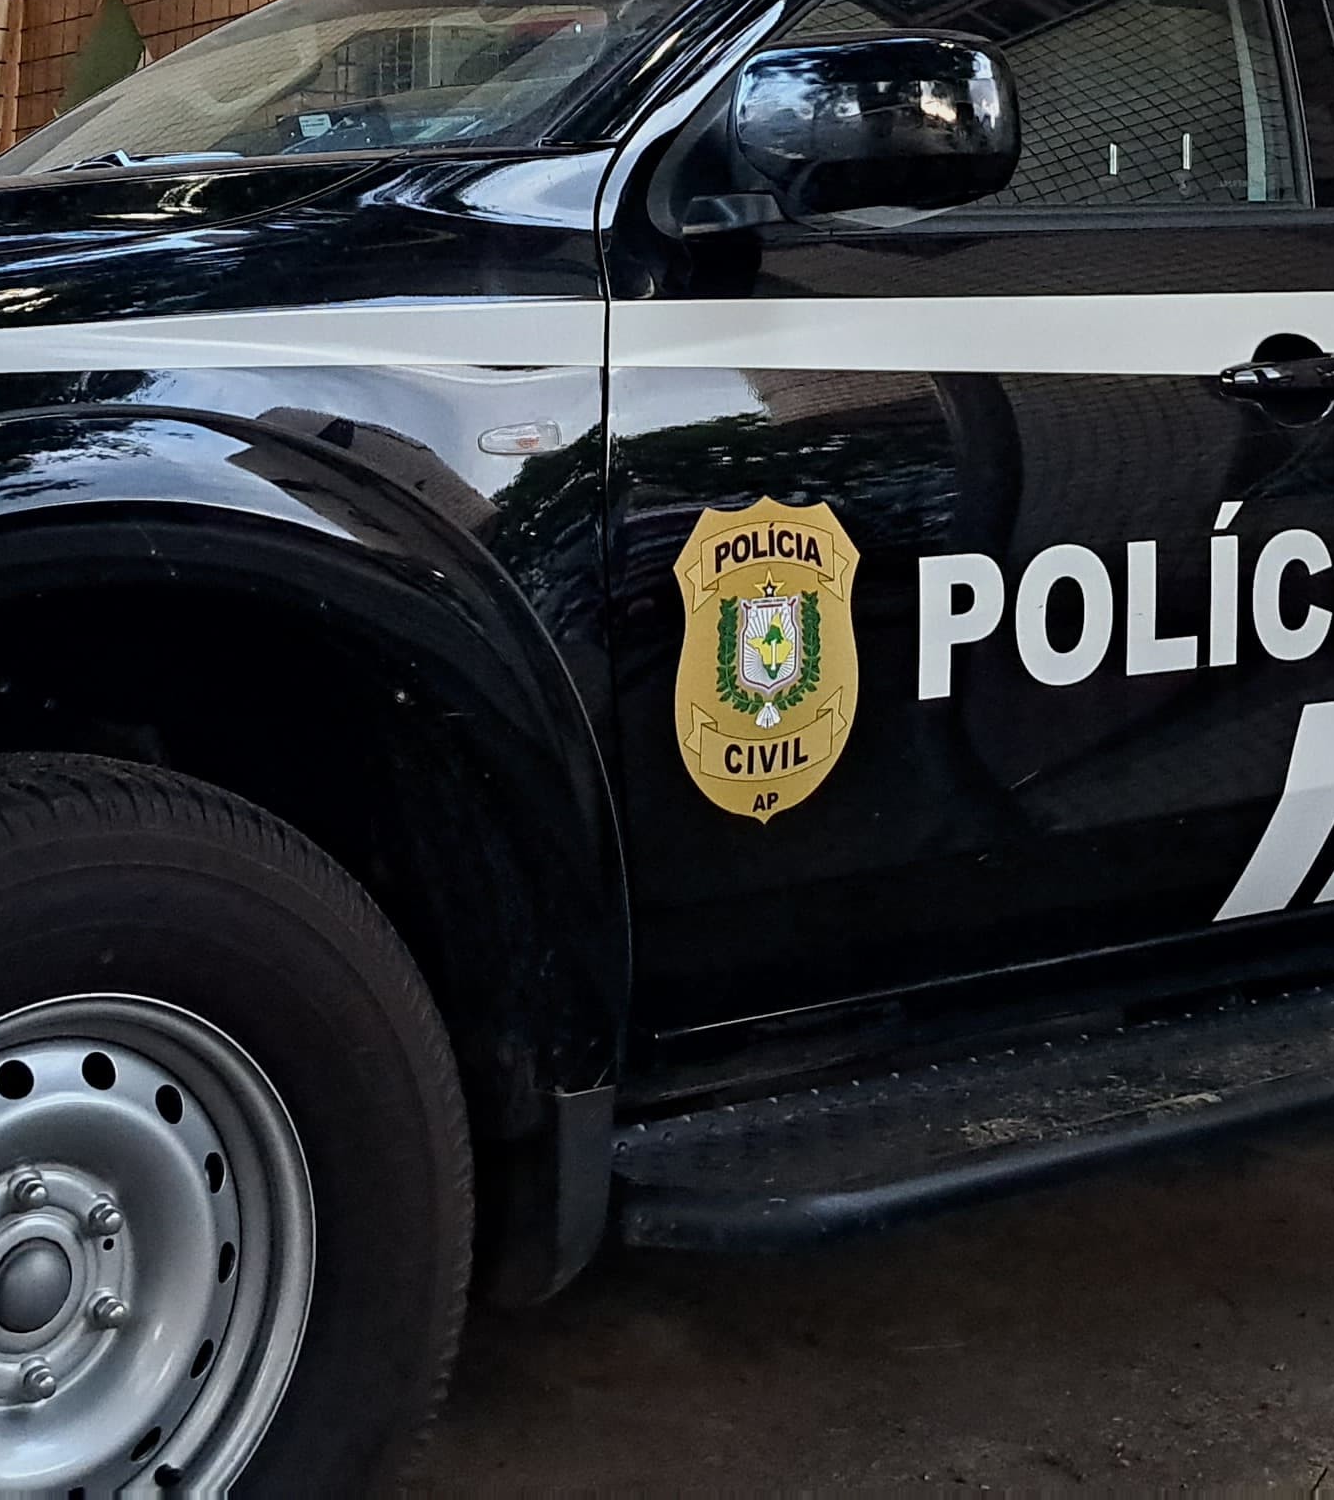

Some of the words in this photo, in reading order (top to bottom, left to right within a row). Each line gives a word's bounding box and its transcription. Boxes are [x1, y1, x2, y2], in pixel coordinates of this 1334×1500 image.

[714, 523, 822, 573] POLÍCIA
[724, 737, 809, 775] CIVIL
[752, 792, 779, 813] AP
